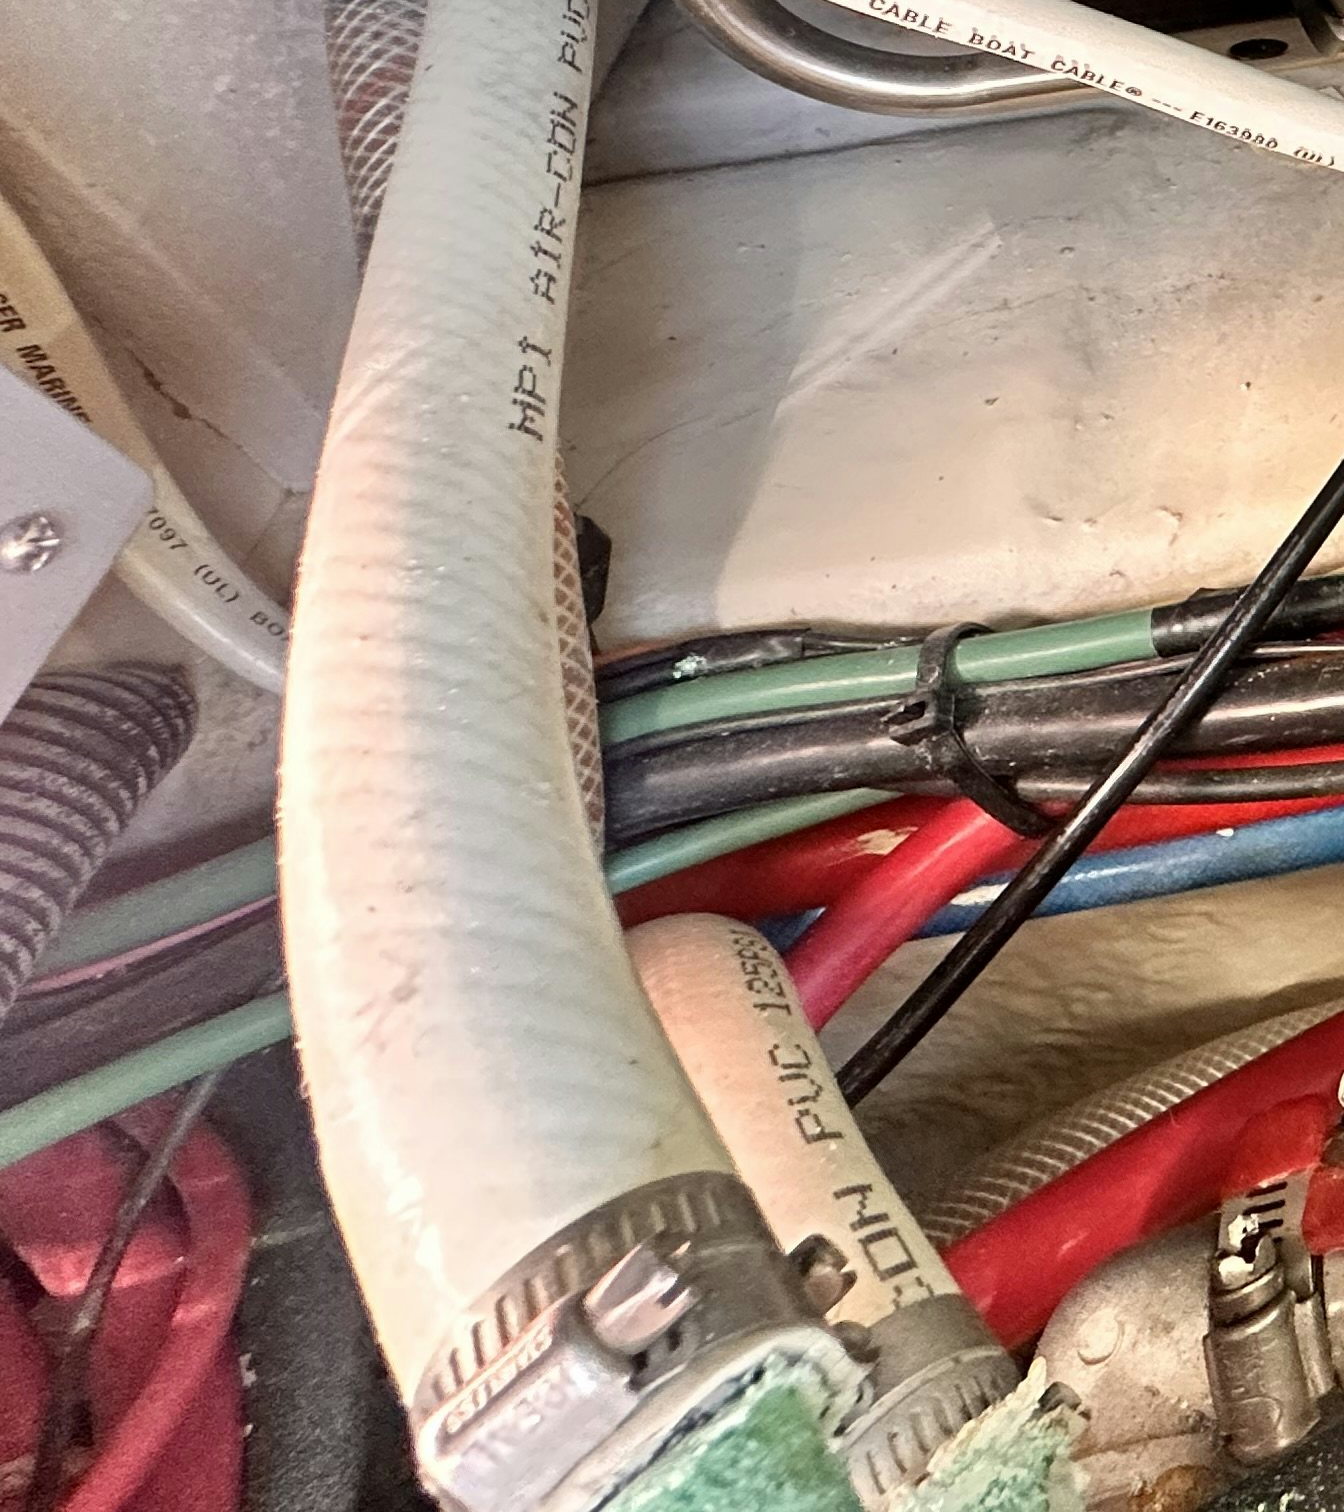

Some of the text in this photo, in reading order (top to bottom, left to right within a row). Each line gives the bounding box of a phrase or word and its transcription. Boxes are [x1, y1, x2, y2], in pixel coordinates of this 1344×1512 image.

[968, 30, 1036, 60] BOAT
[528, 90, 579, 305] AIR-CON
[194, 563, 241, 604] (UL)
[768, 1043, 844, 1145] PVC
